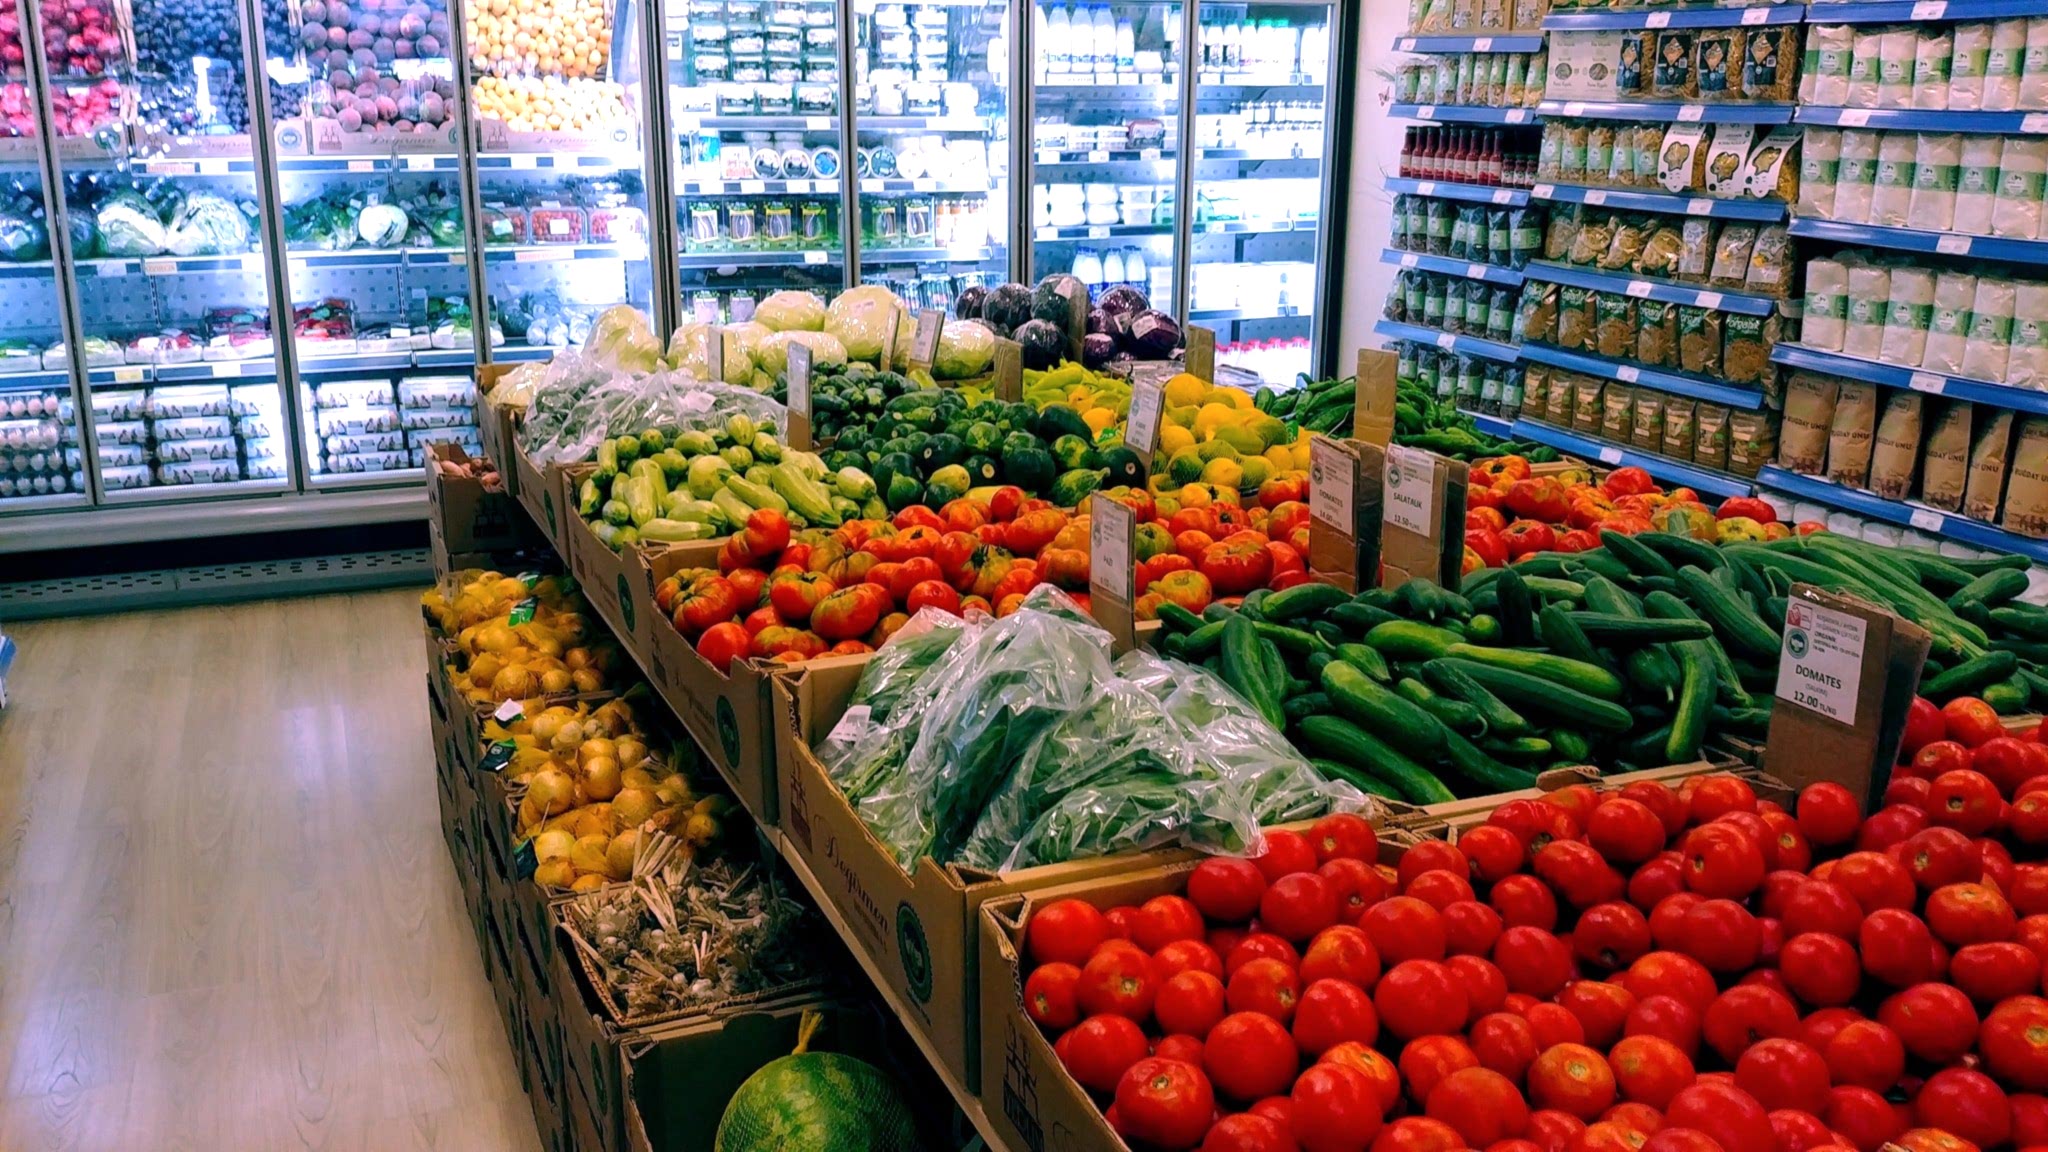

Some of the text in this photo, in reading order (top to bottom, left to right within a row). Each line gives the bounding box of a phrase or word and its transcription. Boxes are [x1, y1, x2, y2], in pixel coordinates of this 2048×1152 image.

[1981, 464, 1999, 473] UNU
[1795, 664, 1842, 689] DOMATES
[1794, 691, 1818, 707] 12.00
